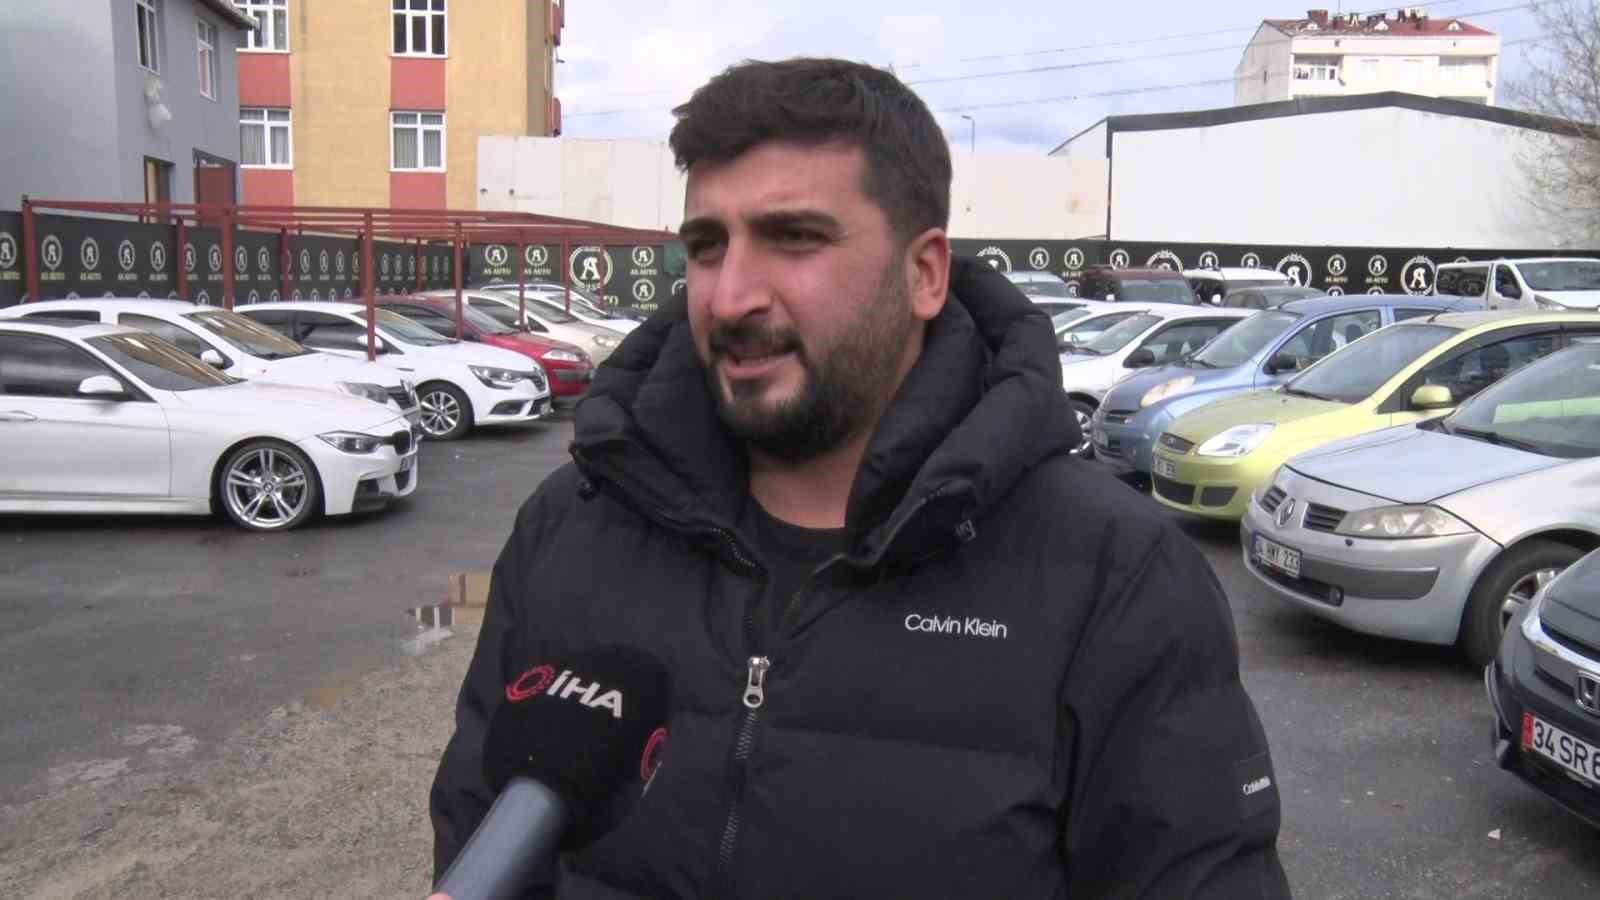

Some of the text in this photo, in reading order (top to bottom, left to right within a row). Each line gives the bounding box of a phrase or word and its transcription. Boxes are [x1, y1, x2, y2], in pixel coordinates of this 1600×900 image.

[905, 613, 1008, 639] Calvin Klein
[1534, 721, 1556, 757] 34
[1560, 735, 1589, 774] SR
